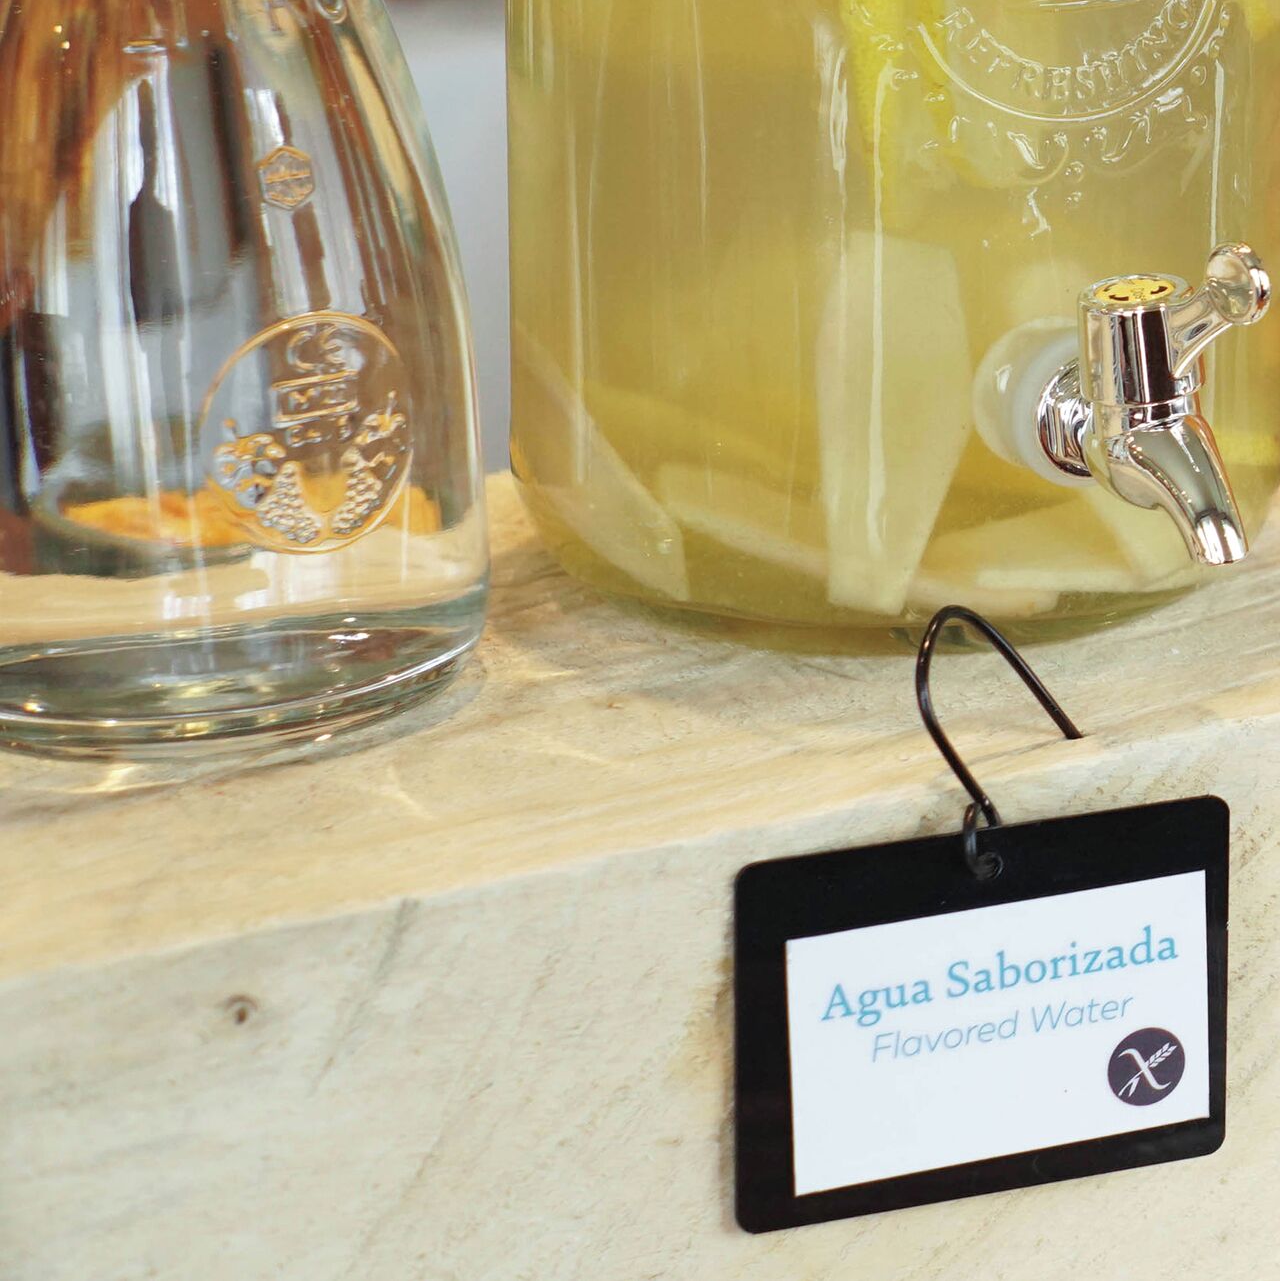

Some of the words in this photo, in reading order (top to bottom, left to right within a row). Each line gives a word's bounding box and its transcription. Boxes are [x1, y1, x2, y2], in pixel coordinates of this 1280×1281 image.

[820, 976, 933, 1028] Agua
[945, 924, 1179, 1000] Saborizada
[871, 1010, 1018, 1064] Flavored
[1030, 992, 1134, 1035] Water
